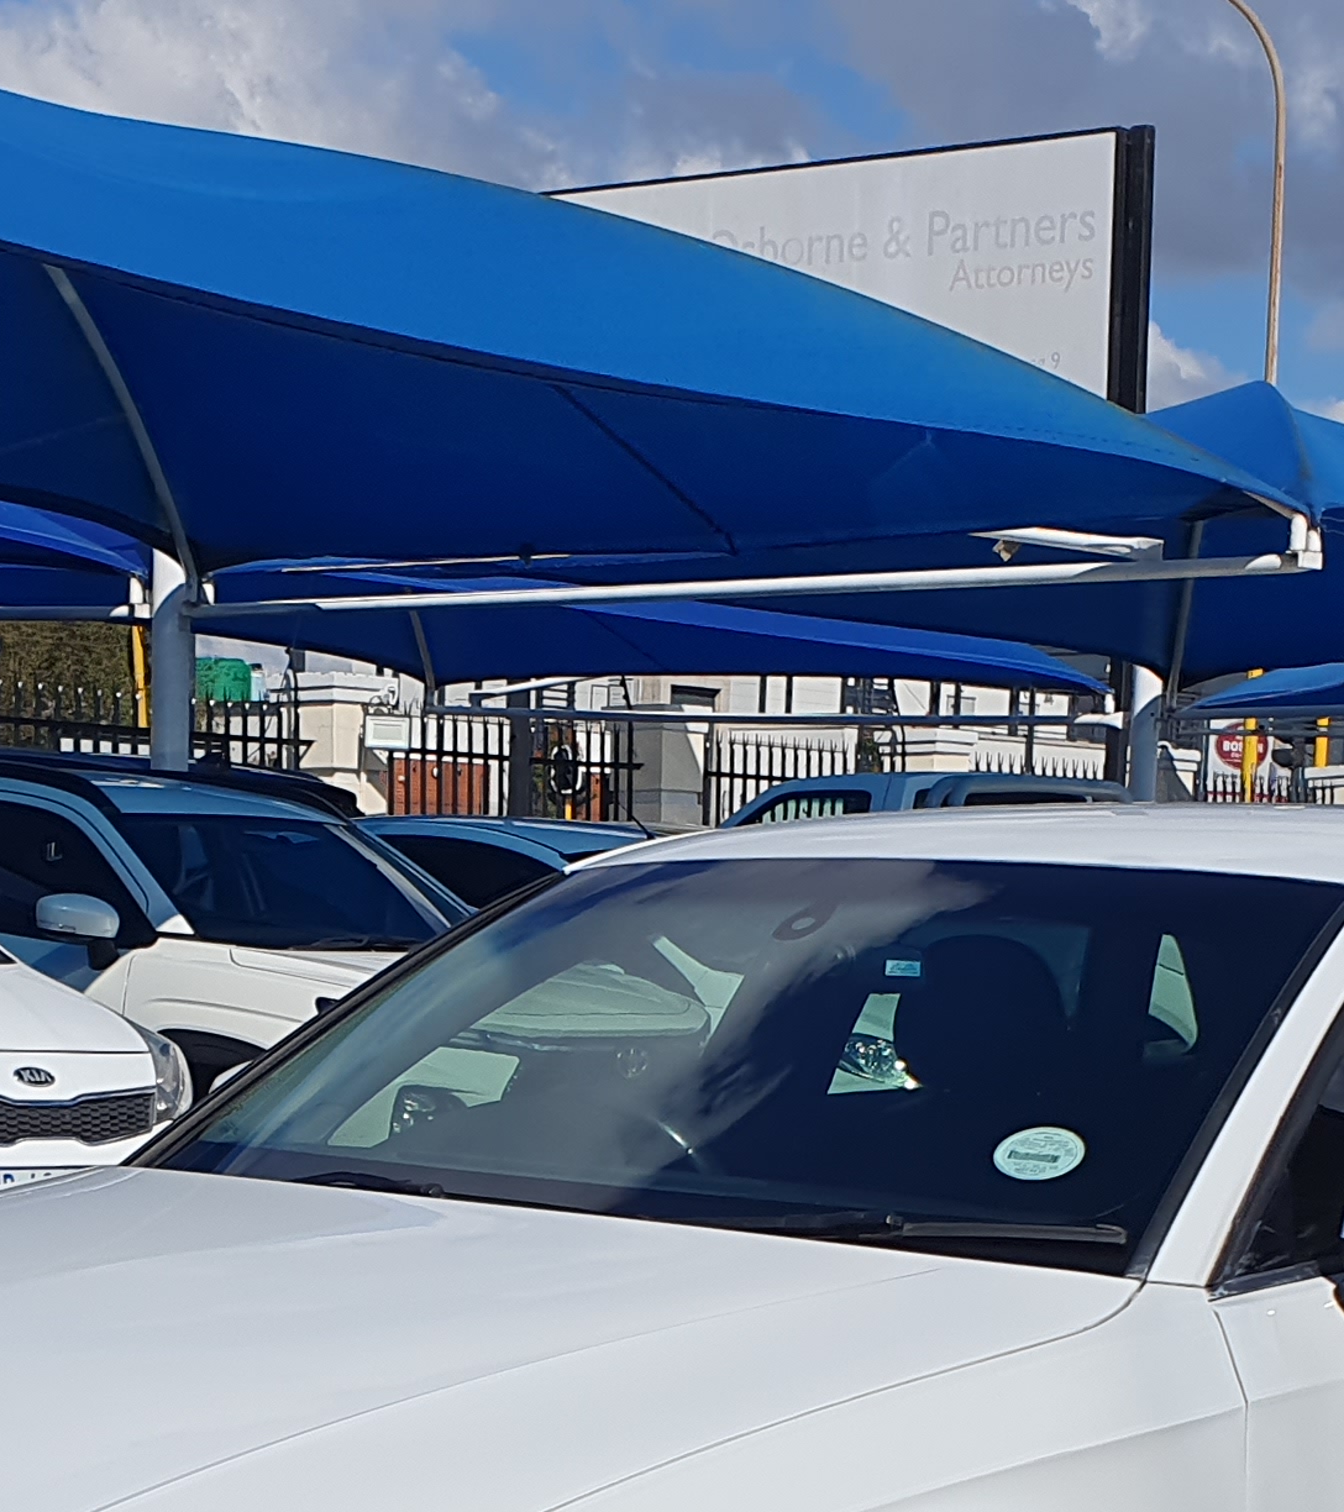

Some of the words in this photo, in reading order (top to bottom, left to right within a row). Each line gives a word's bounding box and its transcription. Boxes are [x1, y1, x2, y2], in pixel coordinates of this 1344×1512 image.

[883, 216, 911, 259] &
[927, 210, 1096, 257] Partners
[949, 257, 1094, 293] Attorneys
[19, 1069, 53, 1083] KIA
